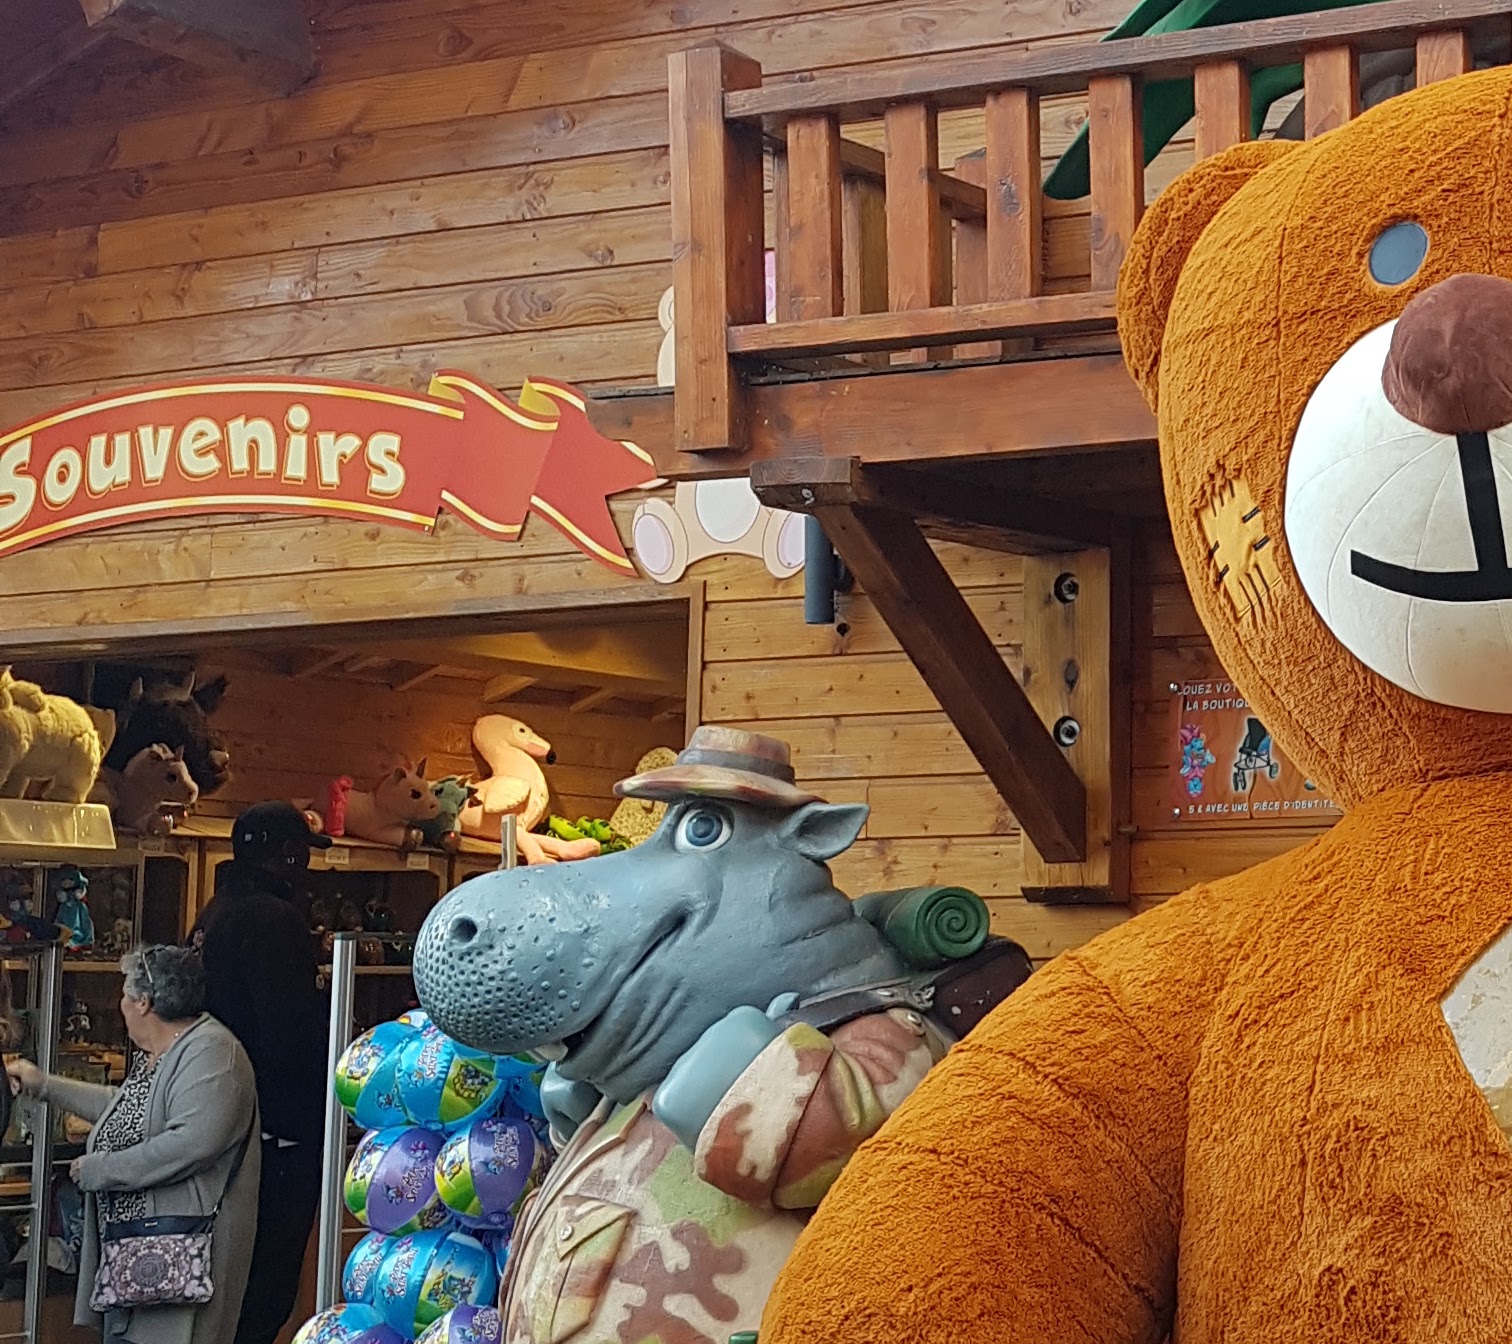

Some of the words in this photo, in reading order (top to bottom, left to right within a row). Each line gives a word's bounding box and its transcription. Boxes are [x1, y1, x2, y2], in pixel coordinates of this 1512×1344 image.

[0, 404, 406, 538] Souvenirs
[1186, 700, 1198, 711] LA
[1206, 804, 1228, 813] AVEC
[1231, 802, 1248, 812] UNE
